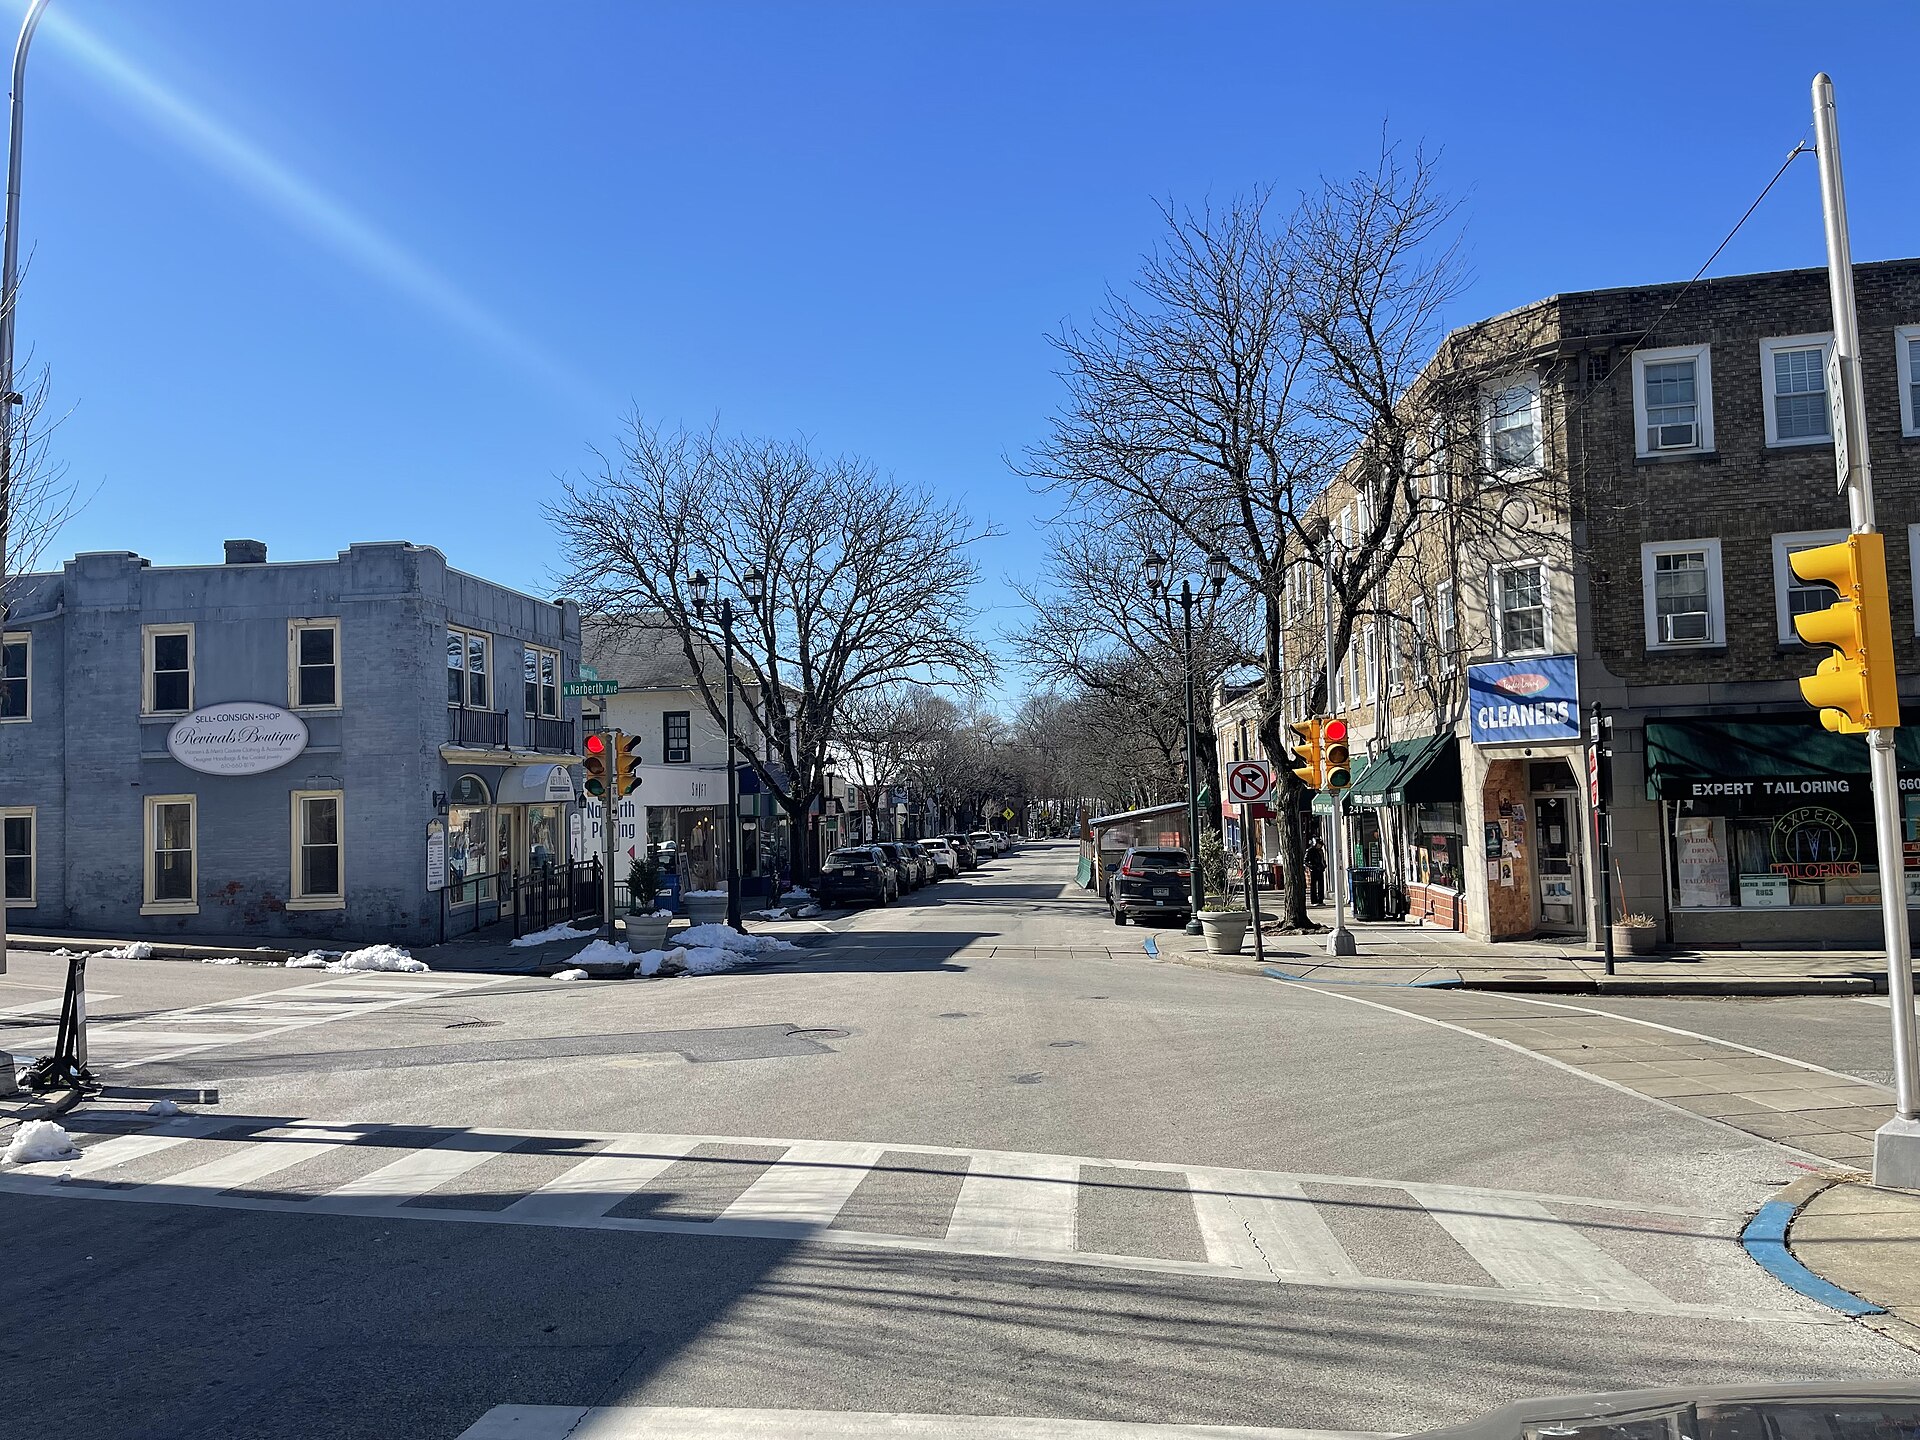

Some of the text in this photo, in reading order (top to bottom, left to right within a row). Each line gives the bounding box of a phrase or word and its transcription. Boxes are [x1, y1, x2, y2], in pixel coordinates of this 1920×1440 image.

[563, 683, 618, 695] N Narberth Ave
[1502, 678, 1540, 691] Tender Loving
[195, 713, 281, 723] SELL CONSIGN SHOP
[1478, 701, 1570, 729] CLEANERS
[175, 726, 300, 746] Revivals Boutique
[1692, 780, 1849, 796] EXPERT TAILORING
[587, 800, 635, 818] Narth
[1779, 808, 1848, 834] EXPERT
[1774, 863, 1860, 878] TAILORING
